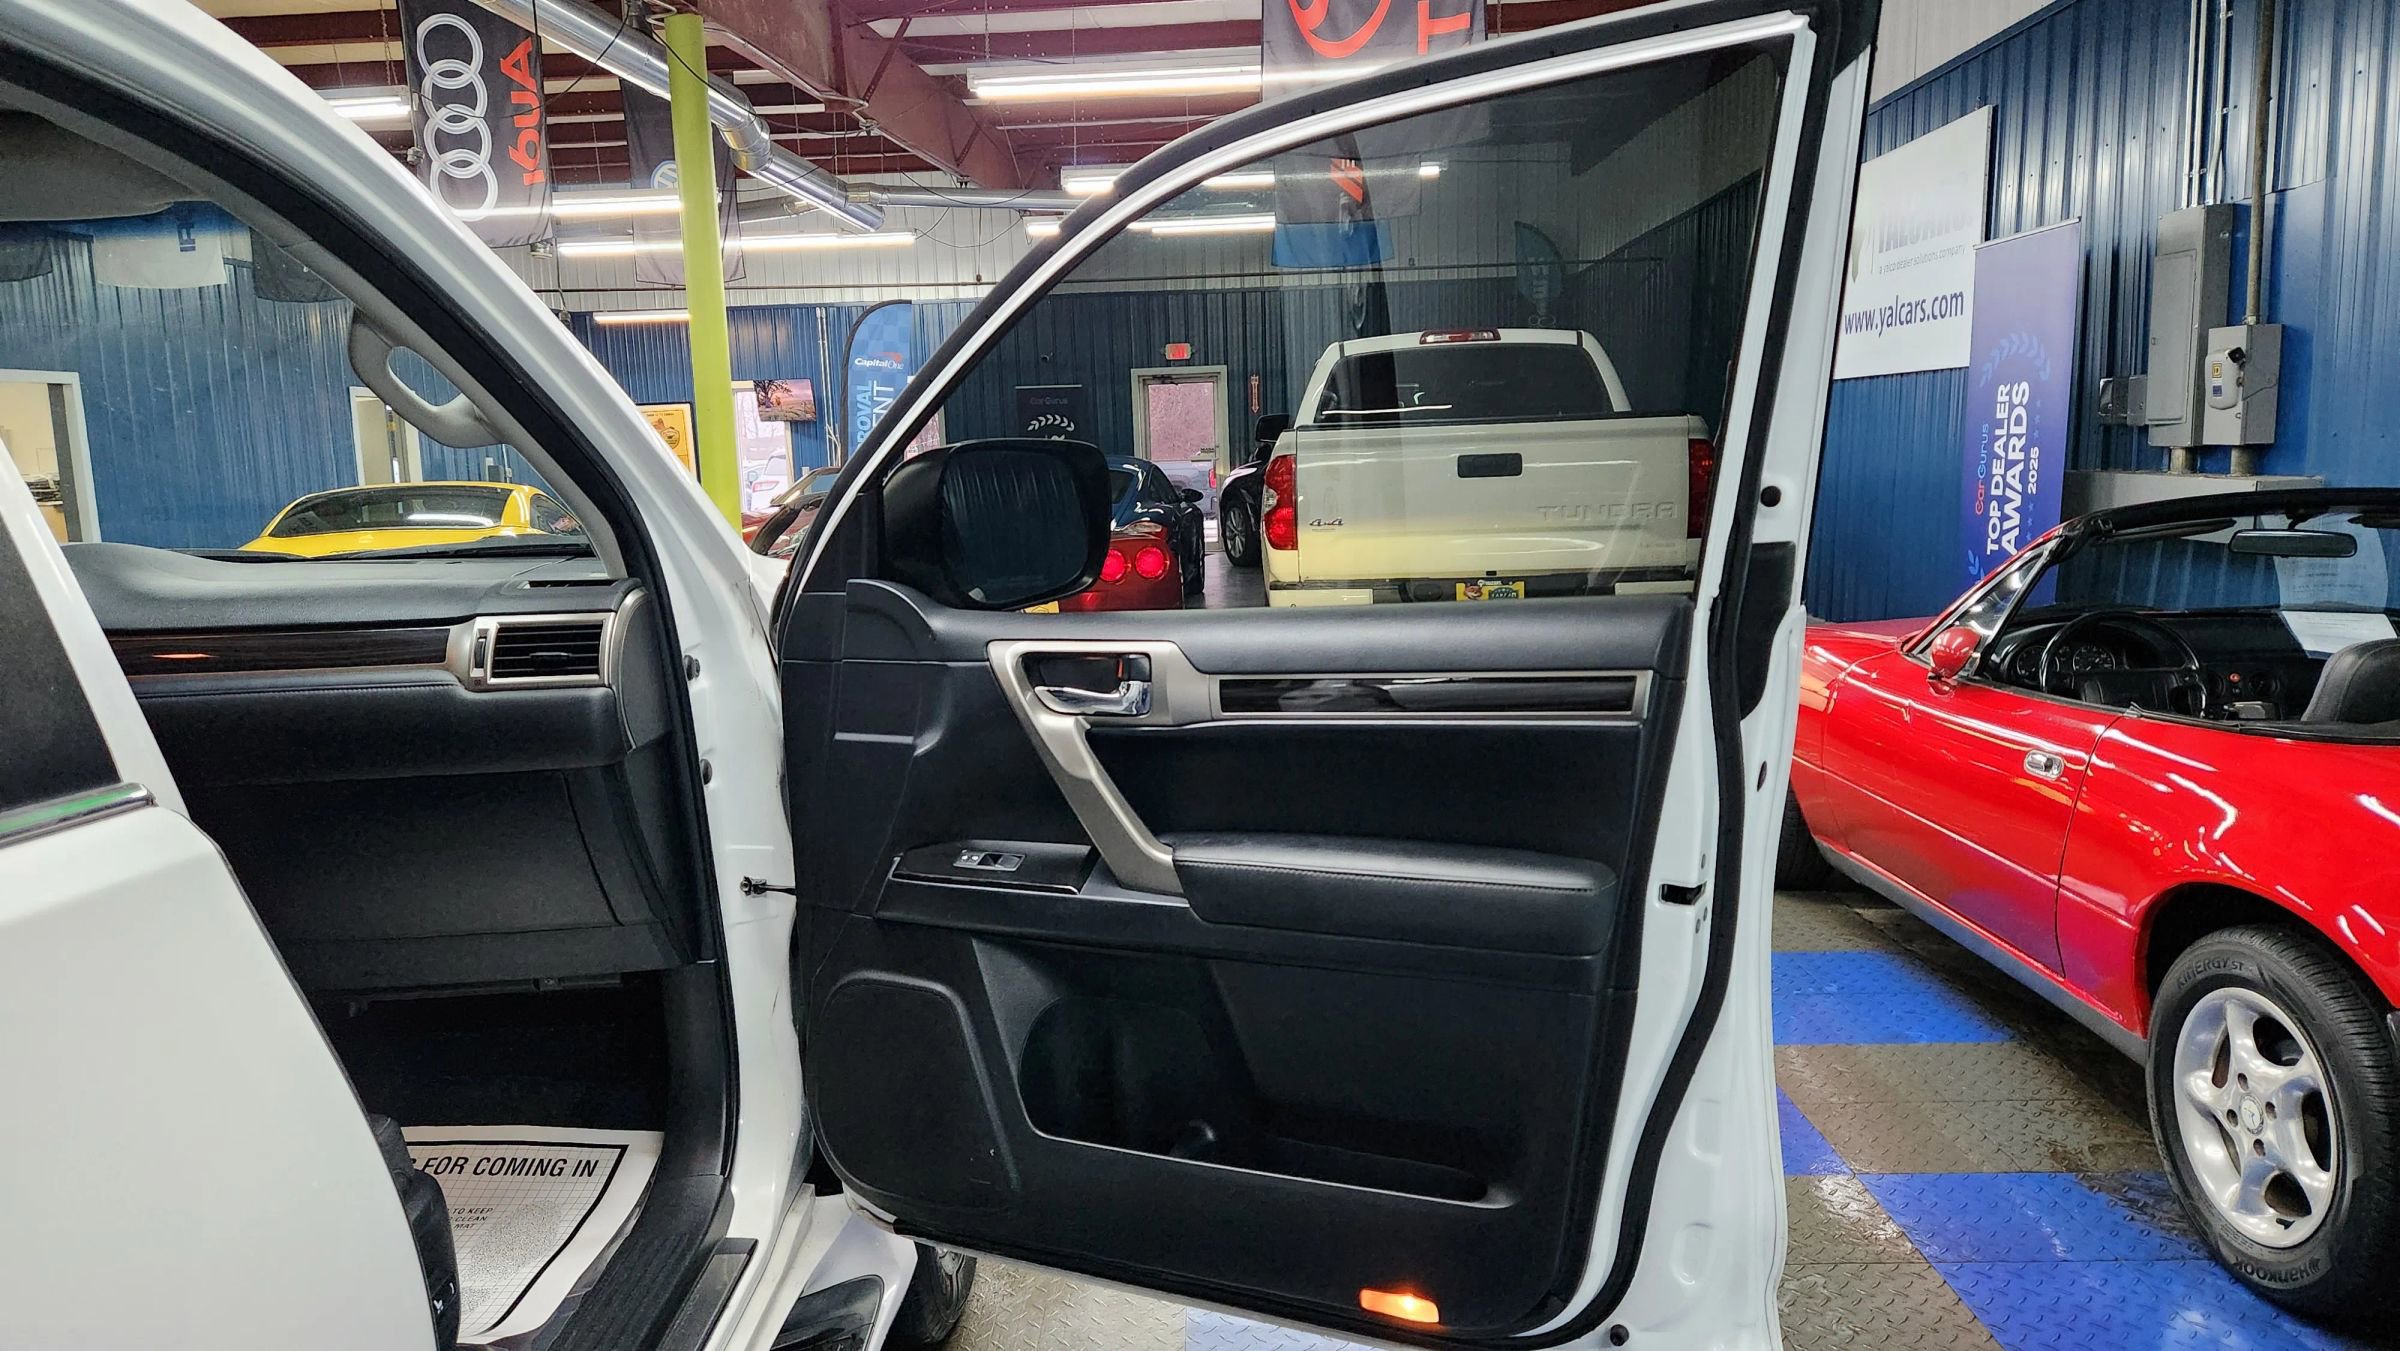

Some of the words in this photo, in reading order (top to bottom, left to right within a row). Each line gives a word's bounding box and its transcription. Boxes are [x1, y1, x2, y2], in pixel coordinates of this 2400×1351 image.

[1844, 290, 1965, 339] www.yalcars.com
[1990, 382, 2012, 497] DEALER
[1975, 423, 1990, 516] CarGurus
[2001, 380, 2031, 557] AWARDS
[2027, 446, 2040, 495] 2025
[1536, 501, 1678, 521] TUNDRA
[1986, 499, 2002, 556] TOP
[2231, 960, 2245, 972] ST
[421, 1156, 469, 1176] FOR
[472, 1156, 568, 1178] COMING
[571, 1158, 600, 1178] IN
[452, 1207, 466, 1215] TO
